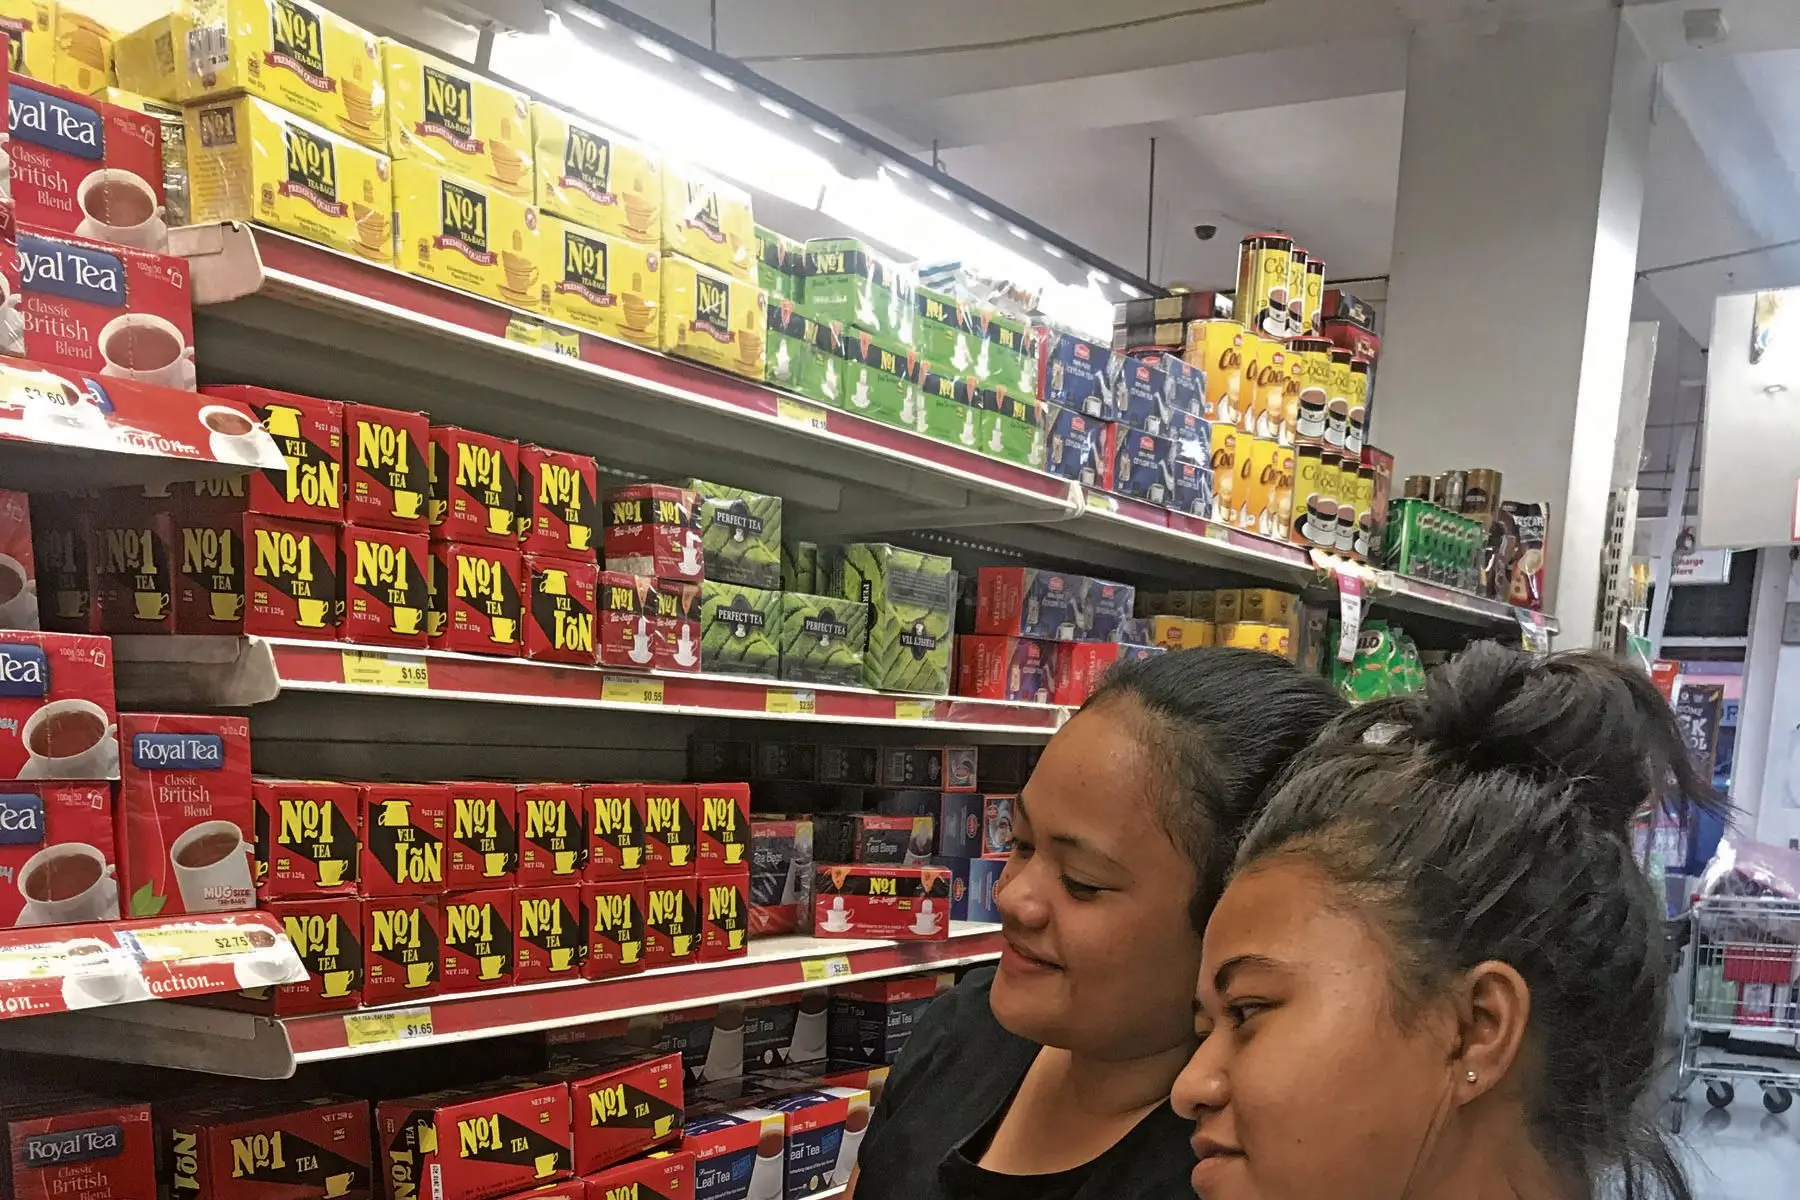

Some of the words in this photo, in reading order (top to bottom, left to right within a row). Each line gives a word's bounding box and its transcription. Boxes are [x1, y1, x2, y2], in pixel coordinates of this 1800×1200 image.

[50, 104, 97, 147] Tea
[11, 146, 52, 169] Classic
[37, 190, 74, 213] Blend
[67, 256, 118, 294] Tea
[27, 297, 71, 320] Classic
[22, 310, 90, 343] British
[55, 340, 94, 361] Blend
[389, 472, 406, 489] TEA
[484, 490, 500, 506] TEA
[565, 508, 579, 523] TEA
[716, 511, 746, 527] PERFECT
[747, 516, 762, 532] TEA
[212, 575, 232, 591] TEA
[291, 580, 312, 597] TEA
[388, 588, 406, 605] TEA
[486, 600, 502, 616] TEA
[718, 608, 748, 623] PERFECT
[748, 613, 763, 625] TEA
[805, 618, 833, 634] PERFECT
[833, 623, 847, 636] TEA
[402, 667, 427, 680] $1.65
[138, 739, 187, 764] Royal
[187, 740, 219, 760] Tea
[164, 774, 197, 786] Classic
[159, 785, 210, 804] British
[184, 804, 213, 817] Blend
[550, 838, 565, 851] TEA
[617, 834, 631, 847] TEA
[667, 832, 680, 844] TEA
[722, 831, 734, 843] TEA
[312, 844, 331, 858] TEA
[480, 839, 495, 852] TEA
[867, 842, 879, 853] Tea
[880, 843, 898, 855] Bags
[203, 886, 232, 900] MUG
[669, 924, 682, 935] TEA
[725, 919, 736, 930] TEA
[214, 936, 249, 949] $2.75
[546, 936, 560, 948] TEA
[617, 930, 631, 942] TEA
[402, 949, 419, 963] TEA
[475, 942, 491, 955] TEA
[318, 957, 336, 971] TEA
[901, 1012, 913, 1024] Tea
[407, 1023, 432, 1036] $1.65
[634, 1102, 650, 1119] TEA
[28, 1136, 80, 1161] Royal
[82, 1131, 117, 1151] Tea
[511, 1138, 529, 1154] TEA
[714, 1144, 727, 1154] Tea
[805, 1144, 821, 1156] Tea
[57, 1164, 94, 1178] Classic
[296, 1155, 319, 1173] TEA
[53, 1171, 109, 1195] British
[695, 1175, 715, 1190] Leaf
[716, 1171, 731, 1184] Tea
